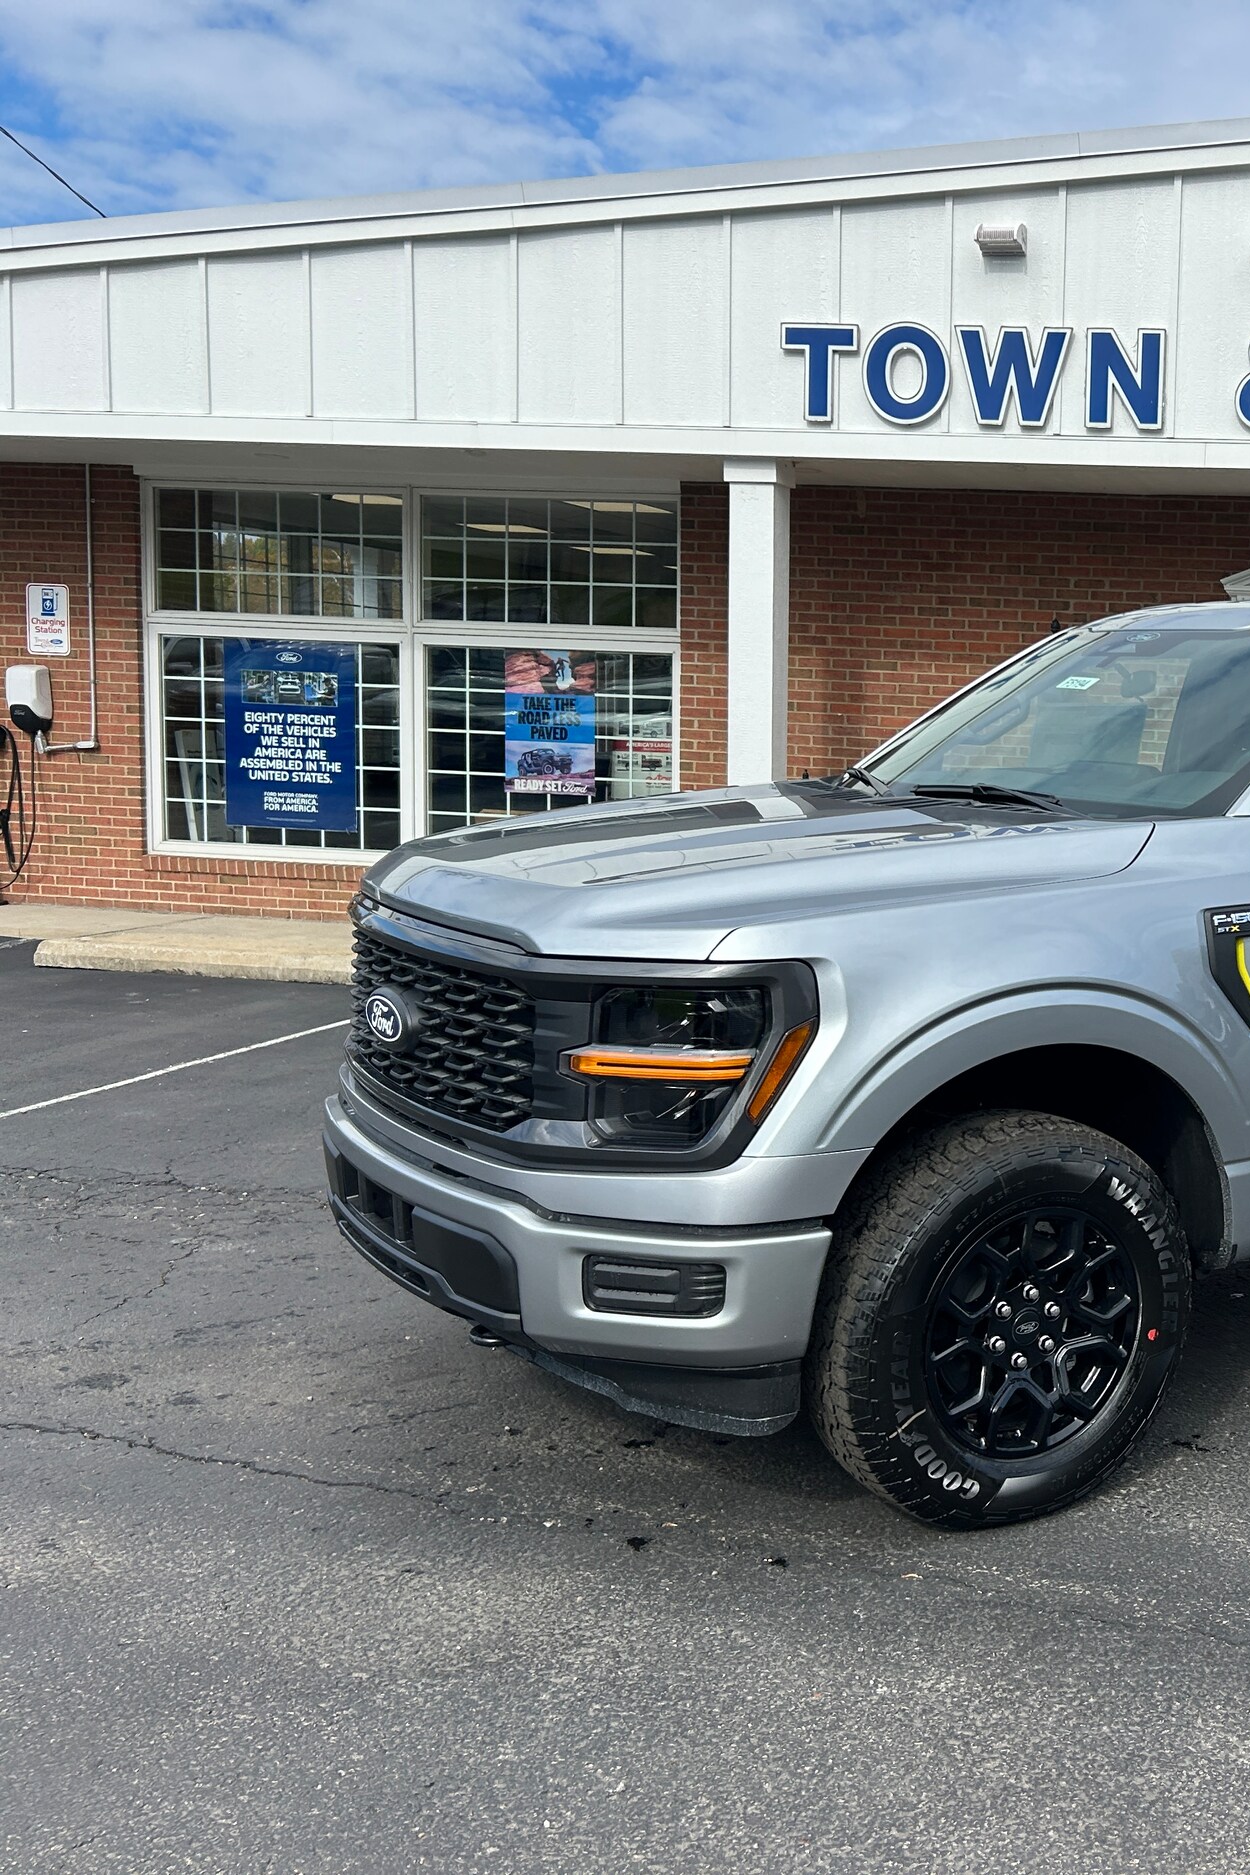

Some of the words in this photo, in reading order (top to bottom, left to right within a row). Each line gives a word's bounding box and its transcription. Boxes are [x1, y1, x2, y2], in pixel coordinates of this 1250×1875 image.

[780, 322, 1167, 430] TOWN
[31, 617, 66, 627] Charging
[35, 626, 63, 634] Station
[280, 652, 299, 662] Ford
[522, 696, 552, 711] TAKE
[553, 697, 577, 712] THE
[244, 711, 285, 723] EIGHTY
[287, 714, 336, 726] PERCENT
[518, 710, 551, 725] ROAD
[553, 712, 581, 727] LESS
[244, 723, 260, 734] OF
[262, 724, 284, 735] THE
[286, 725, 337, 738] VEHICLES
[530, 726, 568, 741] PAVED
[260, 735, 279, 746] WE
[281, 737, 306, 748] SELL
[308, 738, 320, 748] IN
[254, 747, 303, 759] AMERICA
[305, 749, 327, 760] ARE
[240, 758, 303, 770] ASSEMBLED
[305, 761, 318, 772] IN
[320, 762, 342, 773] THE
[248, 769, 289, 782] UNITED
[291, 772, 333, 784] STATES.
[514, 779, 545, 791] READY
[545, 780, 563, 792] SET
[563, 781, 588, 793] Ford
[263, 796, 285, 804] FROM
[286, 798, 319, 806] AMERICA.
[263, 803, 280, 811] FOR
[281, 804, 319, 813] AMERICA.
[1217, 925, 1240, 933] STX
[371, 1000, 394, 1036] Ford
[1106, 1176, 1179, 1332] WRANGLER
